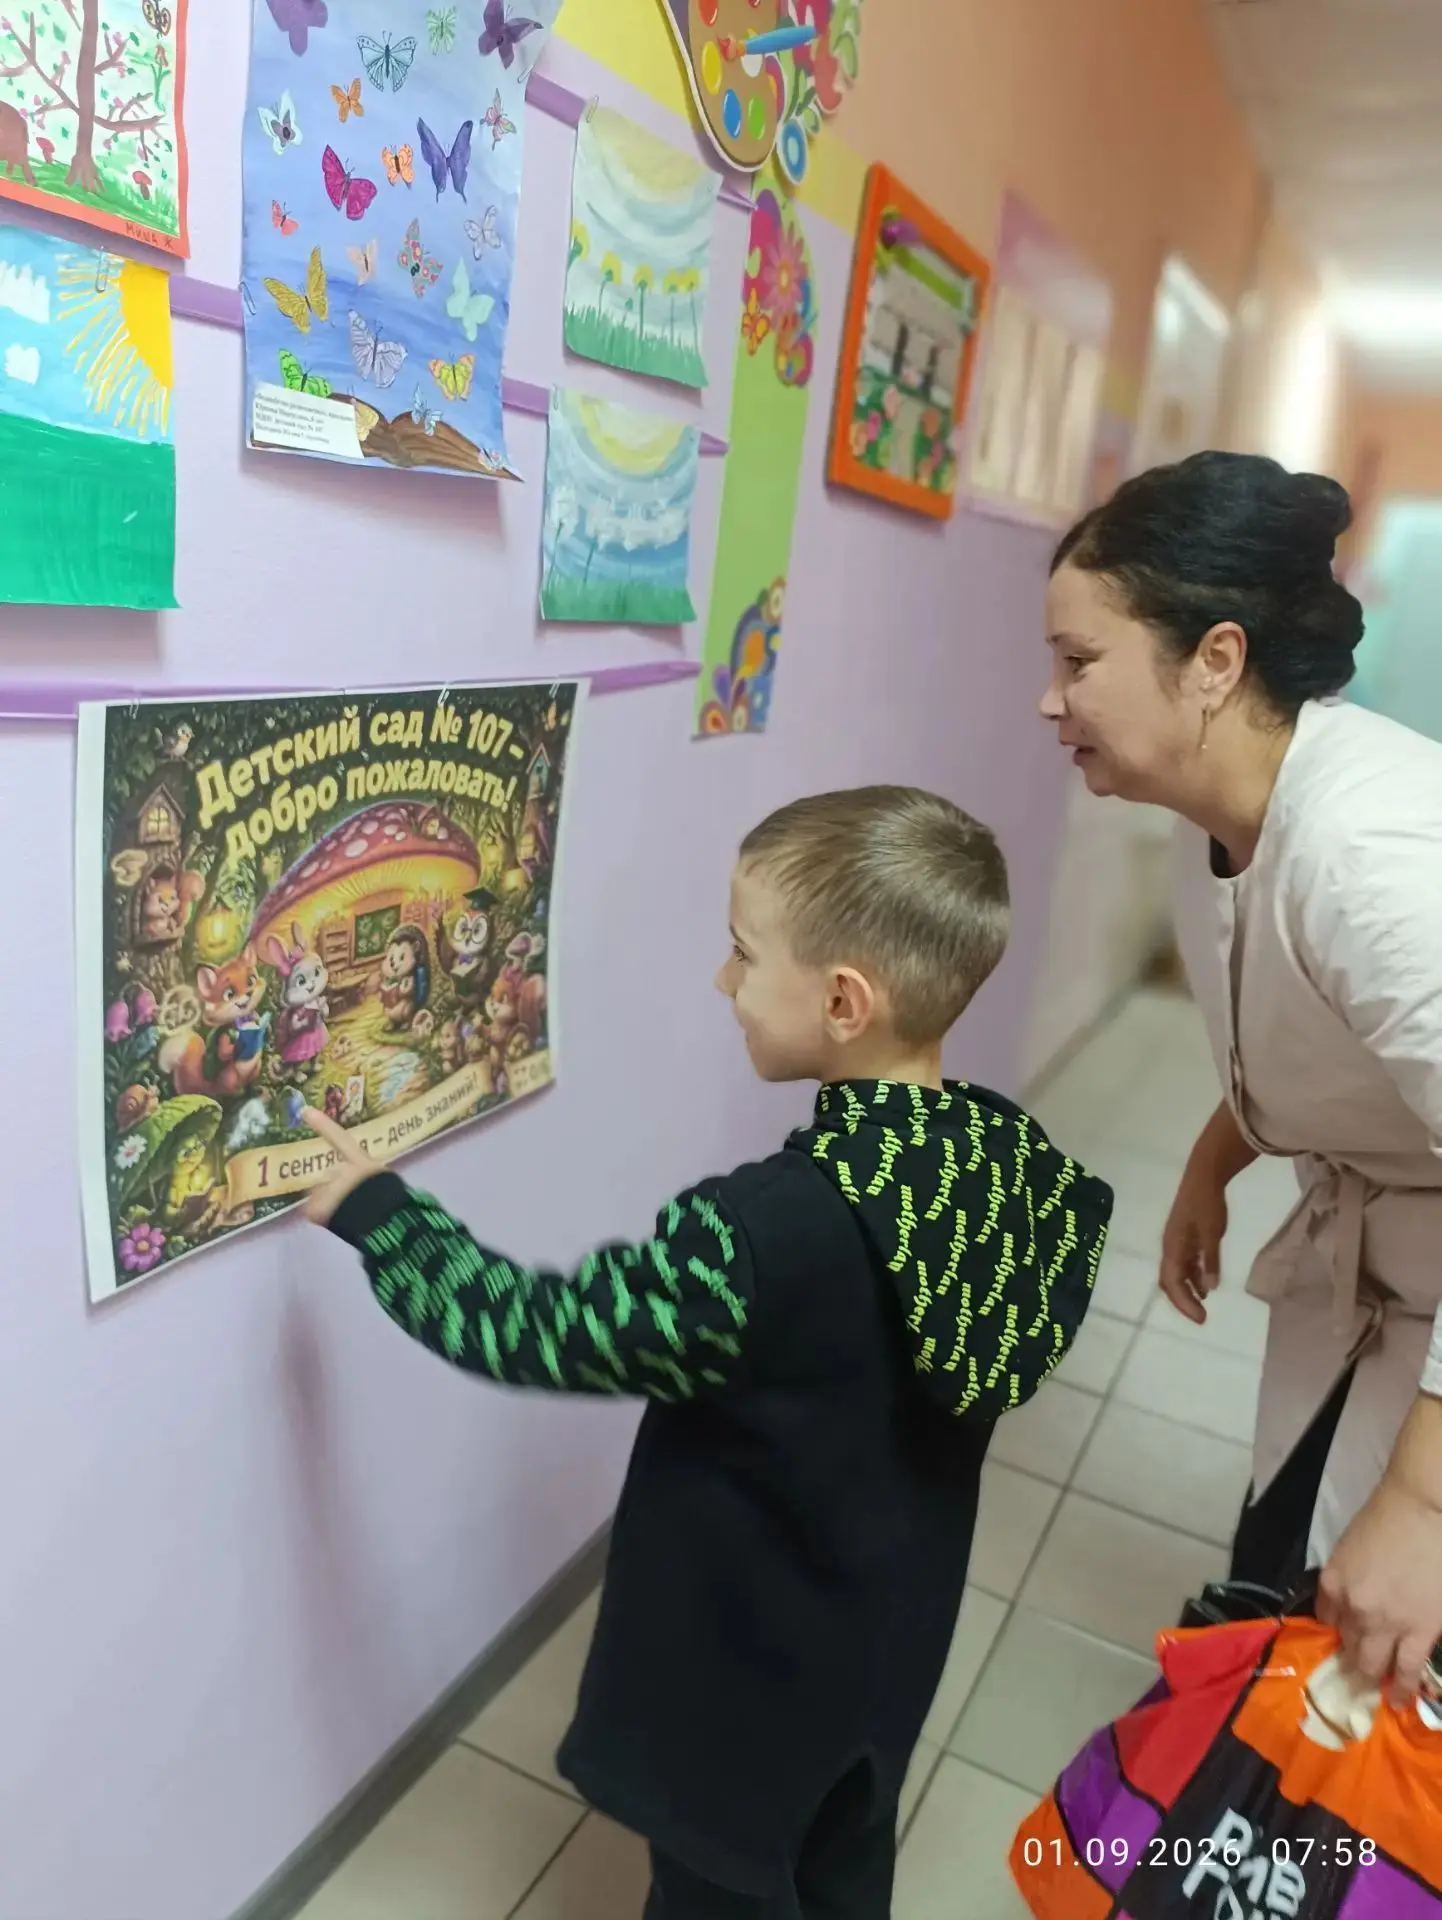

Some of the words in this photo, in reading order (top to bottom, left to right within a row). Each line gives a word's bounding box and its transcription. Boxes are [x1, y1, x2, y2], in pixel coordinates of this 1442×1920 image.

[196, 705, 361, 829] Детский
[369, 711, 424, 748] сад
[430, 706, 463, 743] №
[225, 776, 338, 870] добро
[346, 759, 517, 811] пожаловать!
[257, 1156, 268, 1187] 1
[279, 1138, 368, 1179] сентяя
[388, 1115, 423, 1146] день
[426, 1071, 478, 1123] знаний!
[925, 1138, 959, 1220] motherlan
[975, 1162, 1006, 1244] motherlan
[886, 1184, 918, 1272] motherlan
[936, 1209, 968, 1295] motherlan
[1046, 1209, 1078, 1287] motherlan
[978, 1232, 1016, 1316] motherlan
[943, 1283, 973, 1371] motherlan
[985, 1304, 1020, 1388] motherlan
